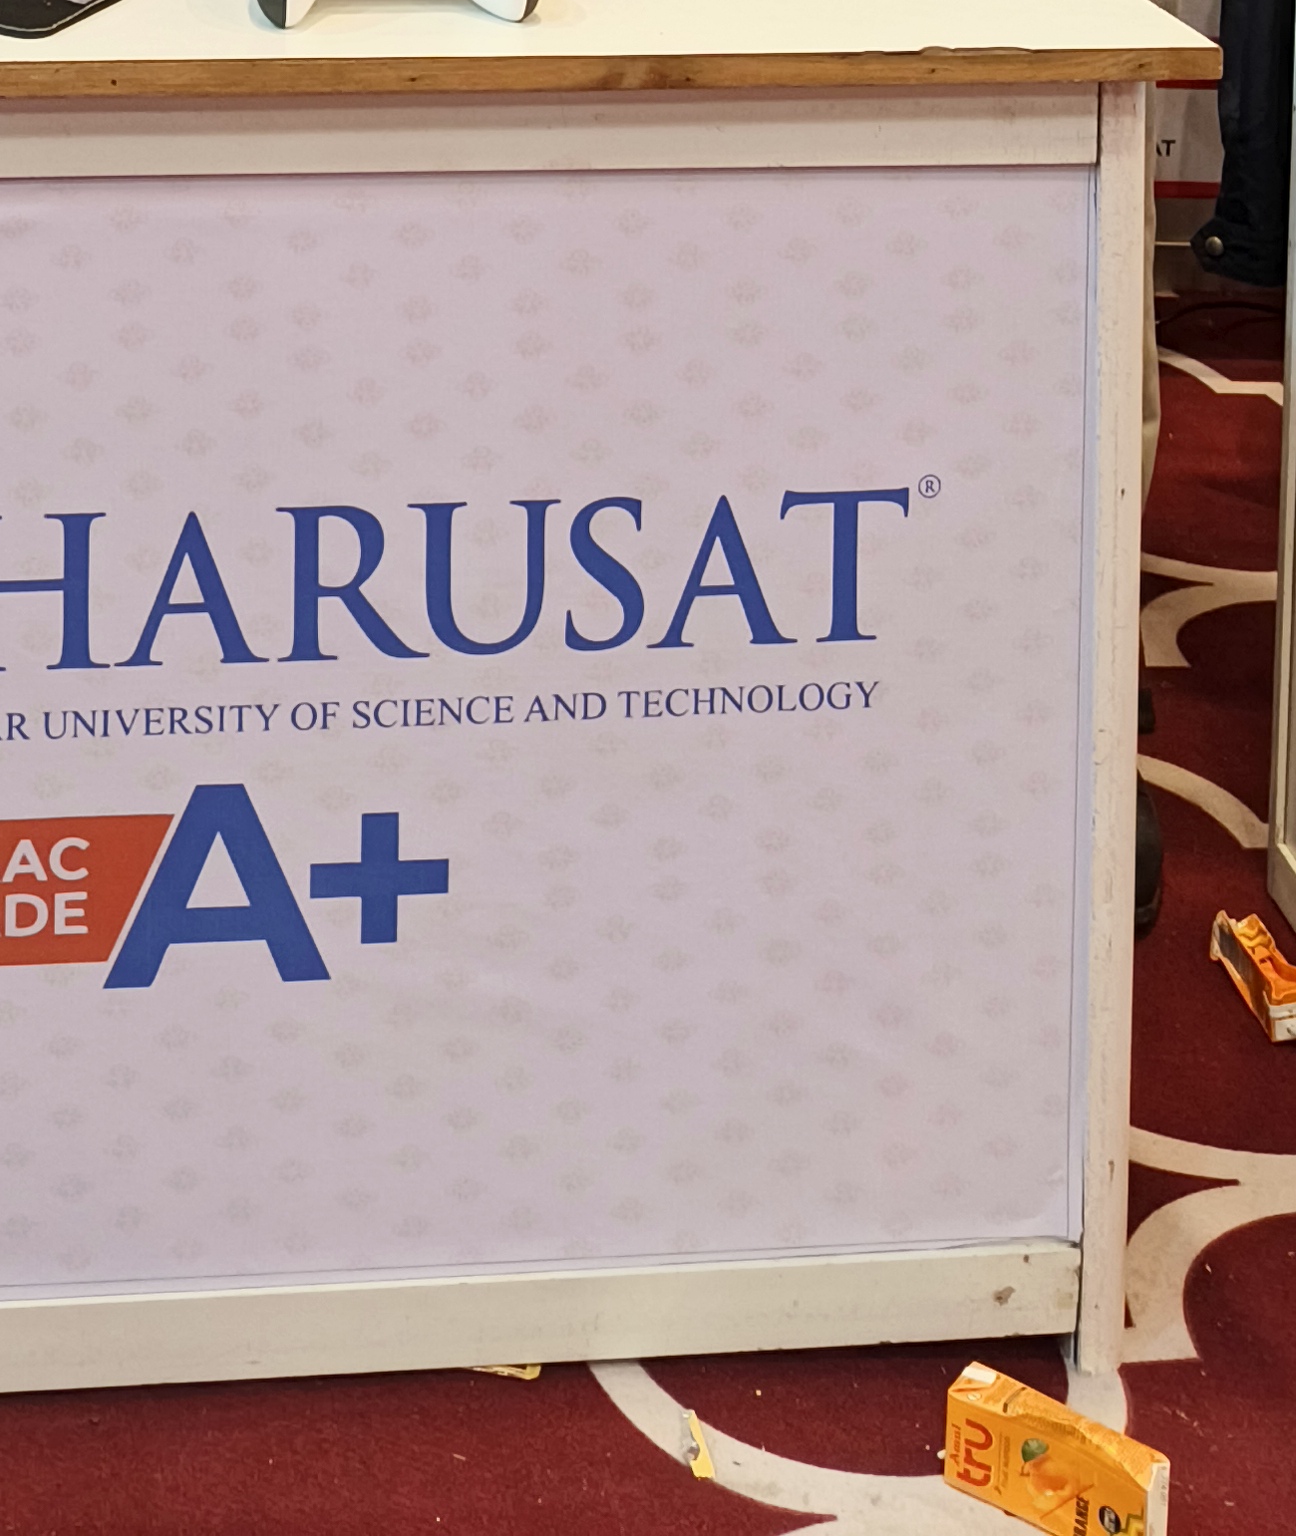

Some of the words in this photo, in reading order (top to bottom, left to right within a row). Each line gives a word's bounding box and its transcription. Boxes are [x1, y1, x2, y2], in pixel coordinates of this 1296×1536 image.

[42, 701, 282, 740] UNIVERSITY
[290, 700, 340, 731] OF
[351, 694, 515, 730] SCIENCE
[523, 690, 608, 725] AND
[617, 680, 881, 720] TECHNOLOGY
[103, 783, 450, 990] A+
[956, 1418, 994, 1487] tru
